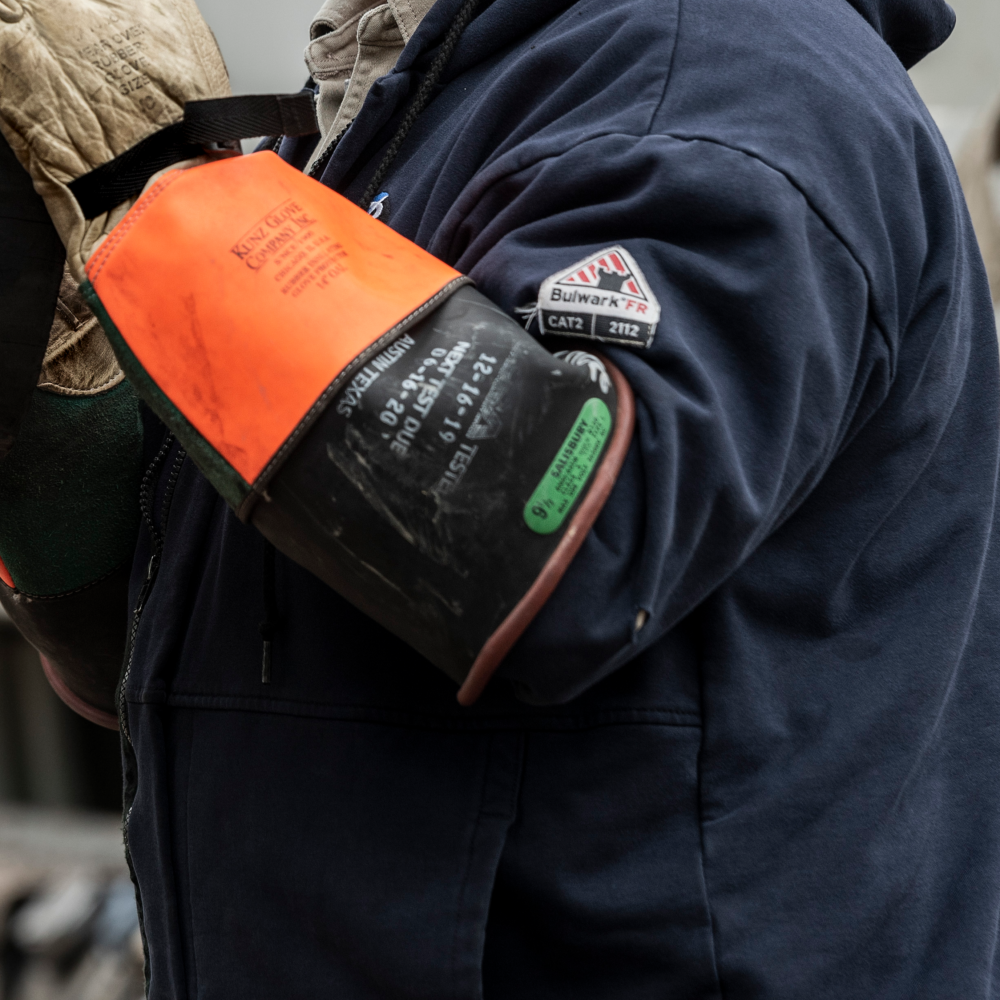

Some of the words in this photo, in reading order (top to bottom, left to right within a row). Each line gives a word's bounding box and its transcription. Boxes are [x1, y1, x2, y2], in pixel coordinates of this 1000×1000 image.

[92, 41, 148, 70] RUBBER
[119, 73, 151, 96] SIZE
[230, 226, 270, 260] KUNZ
[264, 200, 303, 229] GLOVE
[245, 223, 297, 271] COMPANY
[547, 315, 585, 331] CAT2
[608, 320, 640, 338] 2112
[625, 299, 648, 315] FR
[371, 333, 416, 373] AUSTIN
[436, 340, 471, 379] NEXT
[336, 366, 380, 419] TEXAS
[379, 347, 448, 427] 06-16-20
[412, 377, 447, 420] TEST
[438, 352, 498, 443] 12-16-19
[389, 415, 422, 456] DUE
[550, 418, 588, 478] SALISBURY
